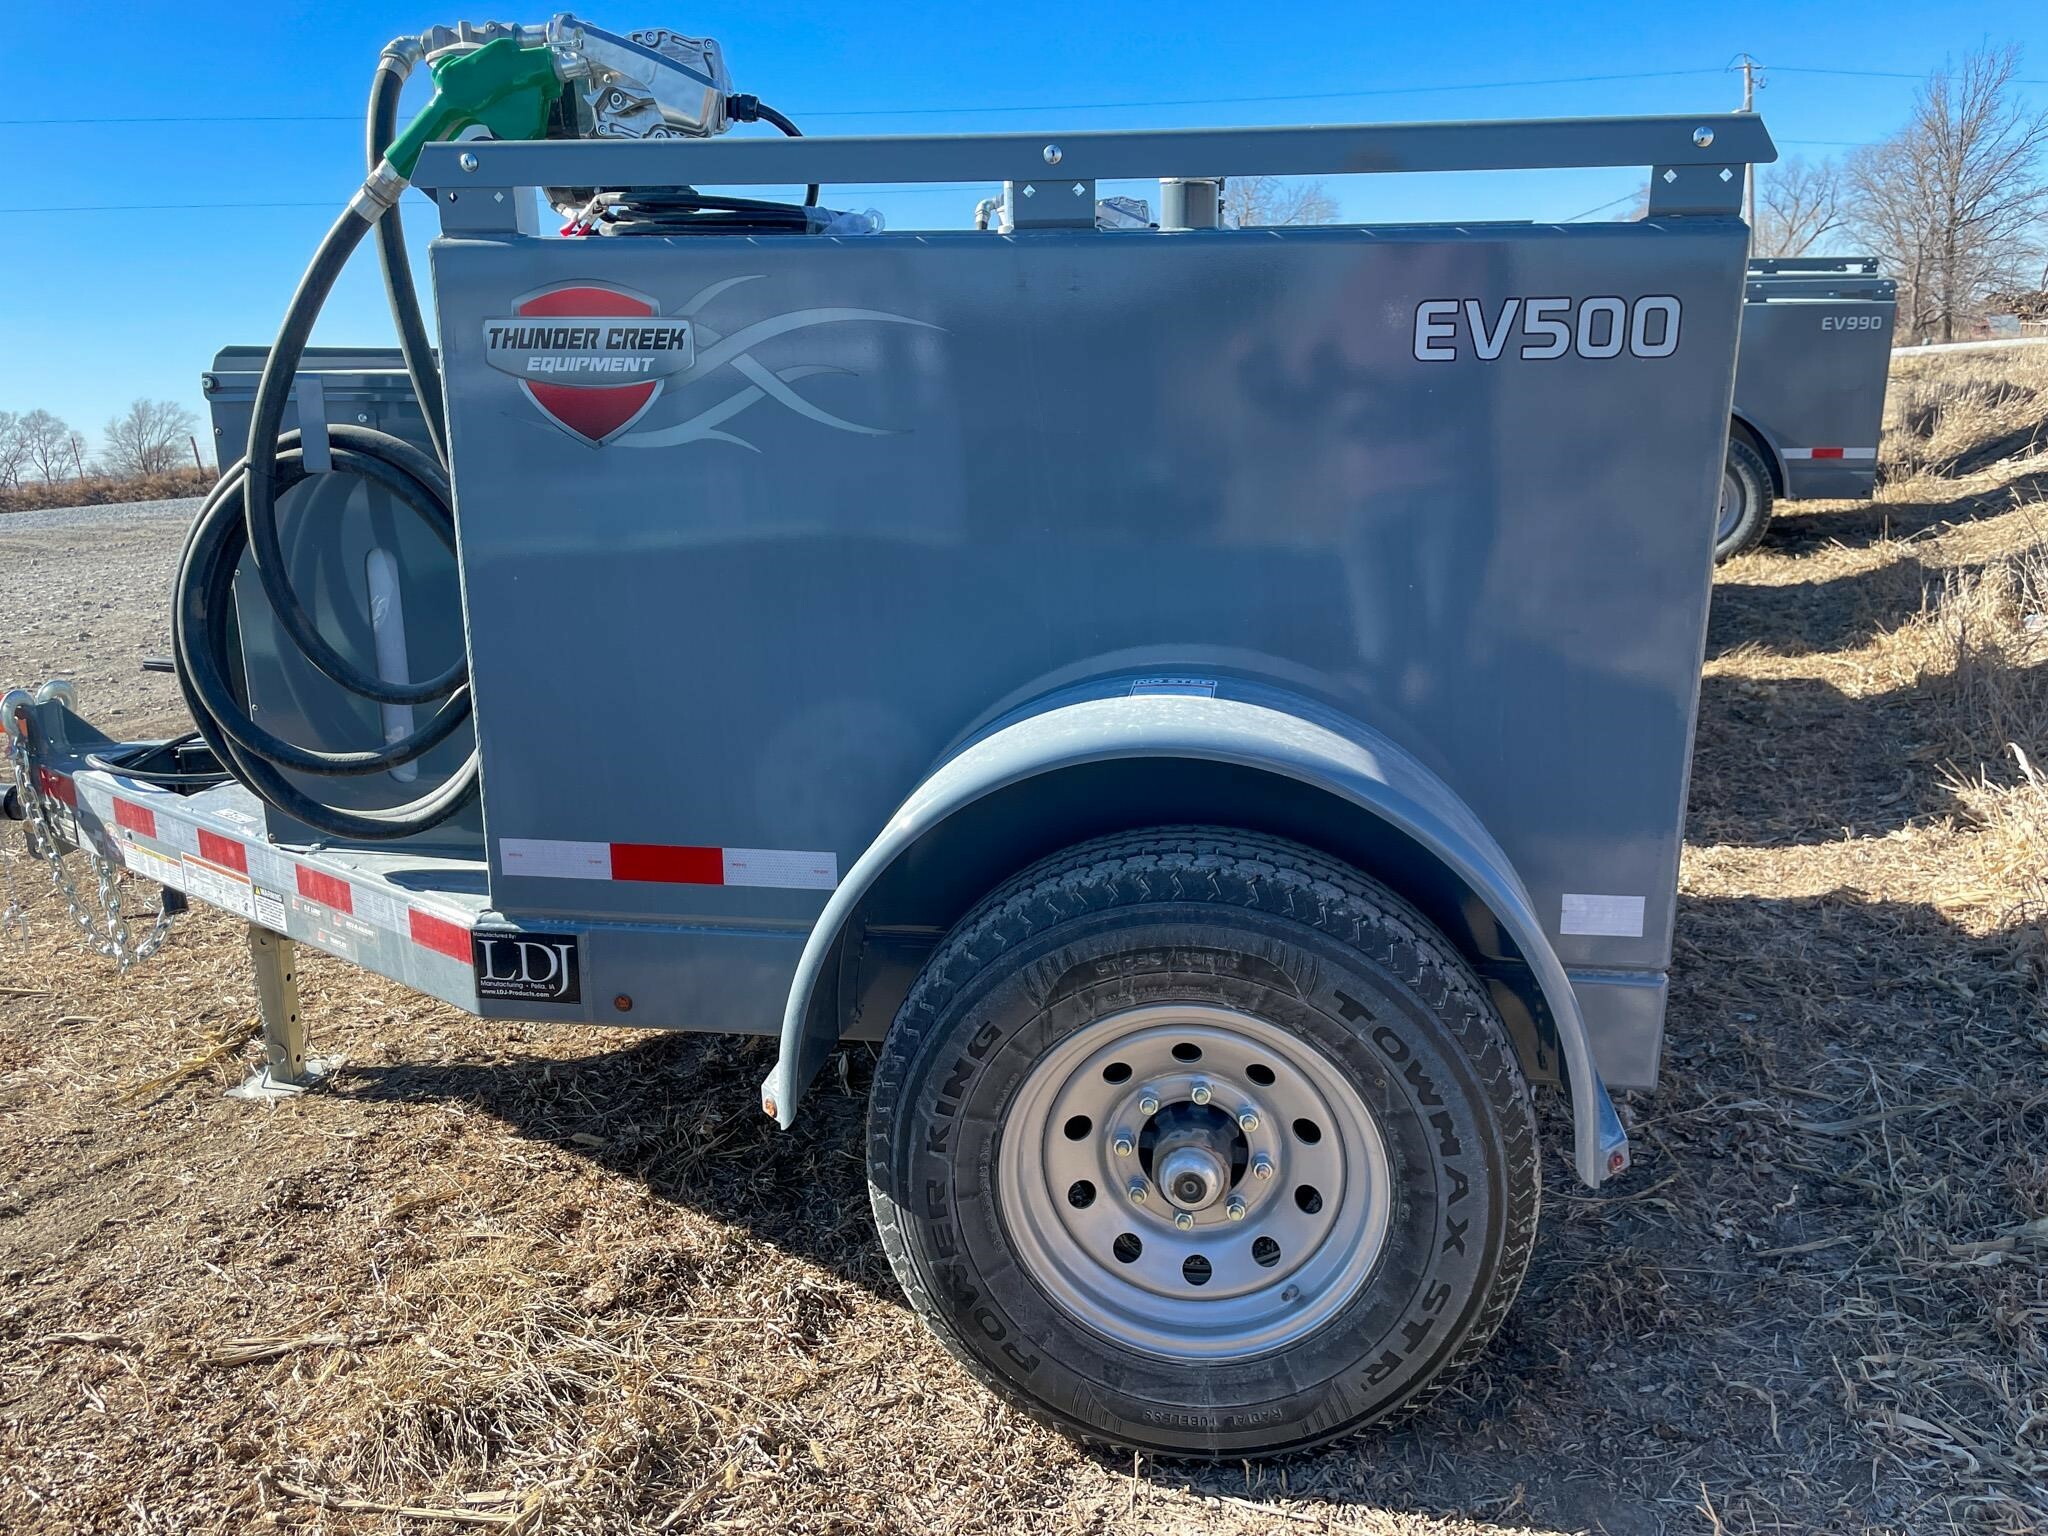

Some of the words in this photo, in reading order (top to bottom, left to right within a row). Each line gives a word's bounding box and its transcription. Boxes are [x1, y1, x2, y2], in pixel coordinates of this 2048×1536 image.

[1413, 294, 1682, 362] EV500
[1821, 316, 1883, 331] EV990
[488, 326, 600, 352] THUNDER
[605, 326, 686, 352] CREEK
[526, 355, 655, 374] EQUIPMENT
[477, 939, 576, 998] LDJ
[480, 980, 525, 989] Manufacturing
[481, 989, 551, 998] www.LDJ-Products.com
[925, 1020, 1003, 1154] KING
[1333, 989, 1470, 1257] TOWMAX
[925, 1179, 1041, 1377] POWER
[1362, 1279, 1452, 1388] STR
[1144, 1408, 1218, 1427] TUBELESS
[1231, 1407, 1284, 1427] RADIAL
